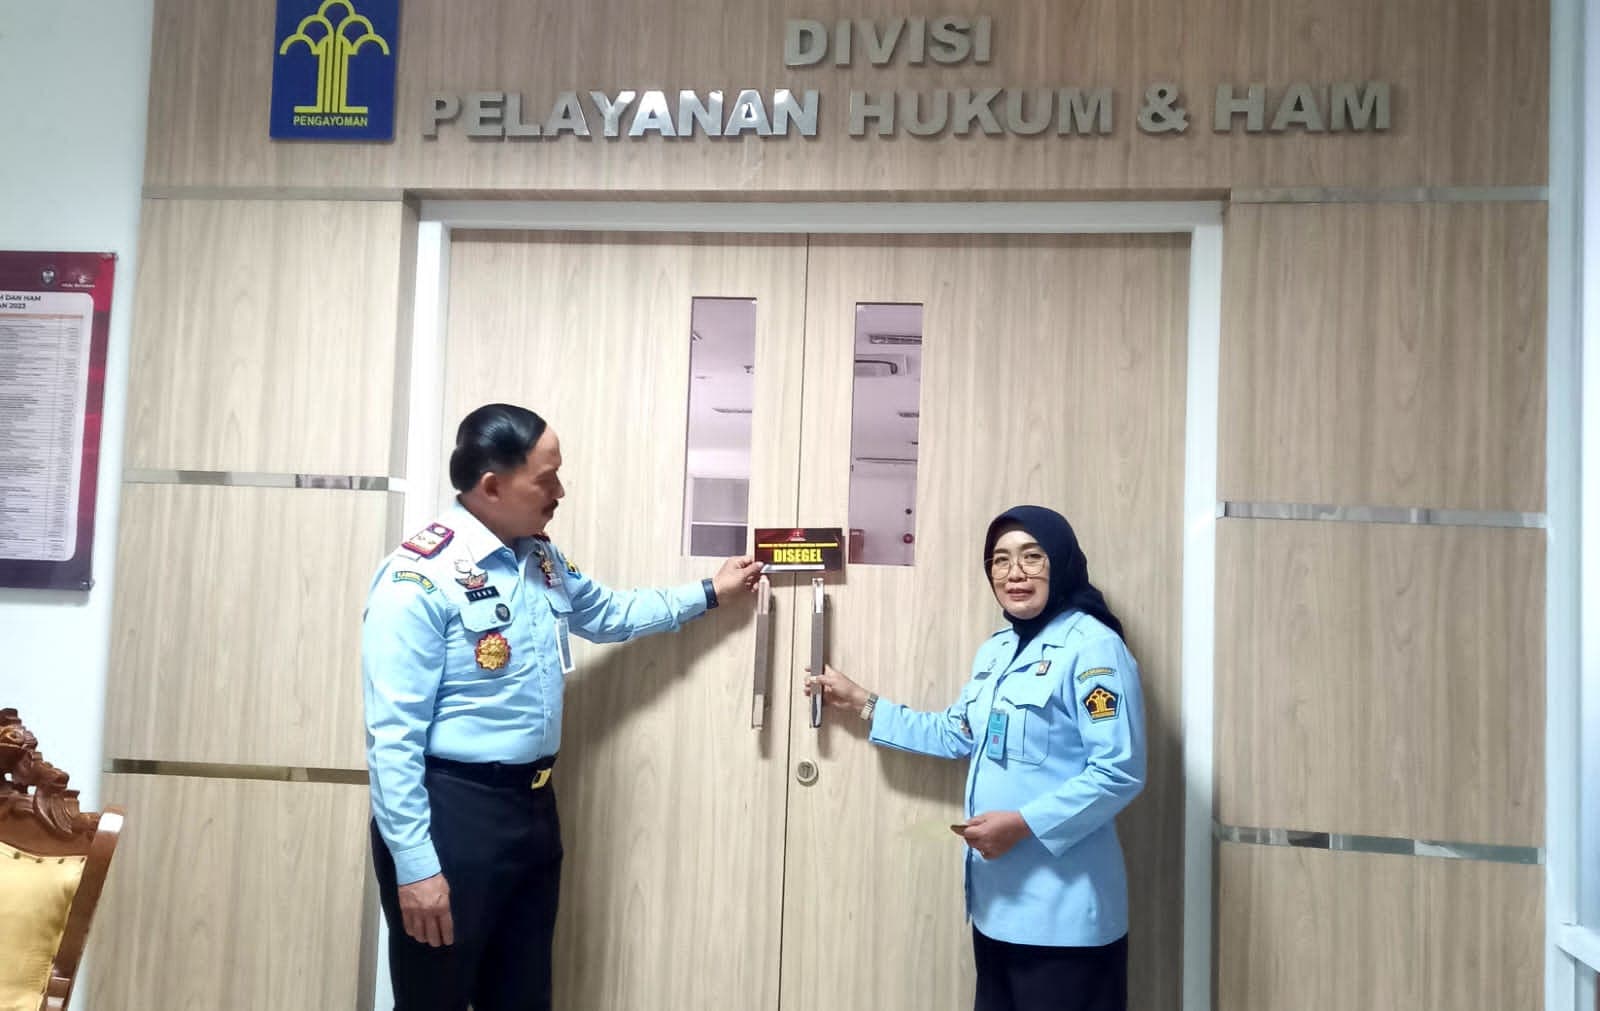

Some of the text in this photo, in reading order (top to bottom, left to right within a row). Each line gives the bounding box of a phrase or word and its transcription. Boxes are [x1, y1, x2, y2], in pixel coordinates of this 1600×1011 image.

[785, 15, 991, 67] DIVISI
[293, 115, 368, 127] PENGAYOMAN
[423, 81, 1391, 137] PELAYANAN HUKUM & HAM
[773, 548, 823, 563] DISEGEL
